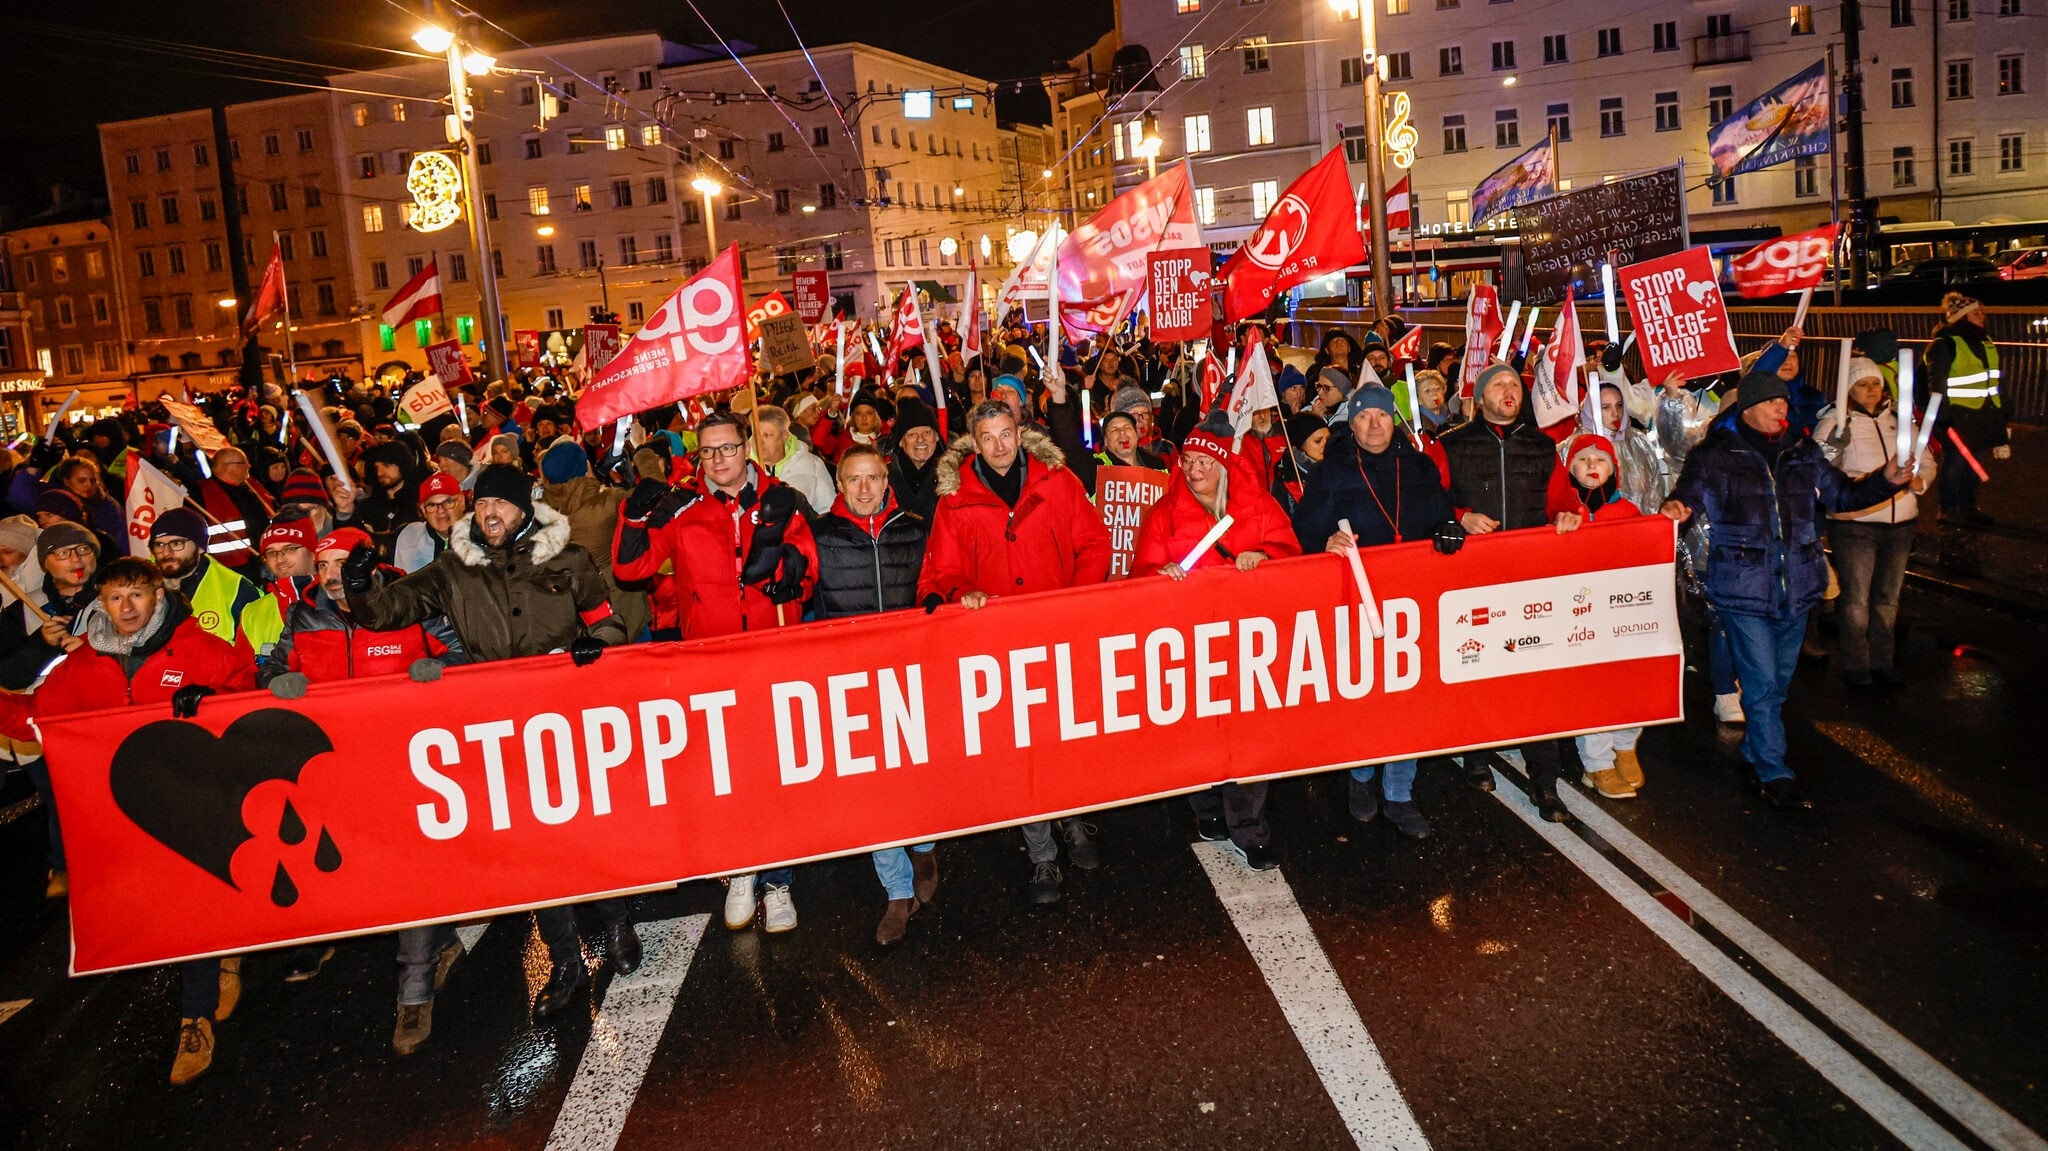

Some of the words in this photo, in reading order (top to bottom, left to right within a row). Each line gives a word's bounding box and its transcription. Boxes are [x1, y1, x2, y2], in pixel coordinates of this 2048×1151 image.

[1420, 221, 1475, 236] HOTEL
[1153, 258, 1192, 278] STOPP
[1154, 277, 1178, 295] DEN
[1630, 267, 1687, 301] STOPP
[1155, 291, 1206, 312] PFLEGE-
[1636, 294, 1674, 323] DEN
[1156, 309, 1192, 329] RAUB!
[1643, 309, 1718, 345] PFLEGE-
[1648, 334, 1705, 368] RAUB!
[1103, 504, 1141, 527] SAM
[1106, 525, 1134, 551] ÜR
[1609, 590, 1653, 605] PRO-GE
[1456, 613, 1469, 625] AK
[1523, 601, 1553, 620] gpa
[1572, 602, 1593, 617] gpf
[1567, 625, 1596, 643] vida
[1612, 621, 1659, 638] younion
[367, 645, 391, 657] FSG
[163, 674, 181, 683] FSG
[408, 689, 737, 840] STOPPT
[771, 663, 929, 786] DEN
[958, 597, 1422, 757] PFLEGERAUB
